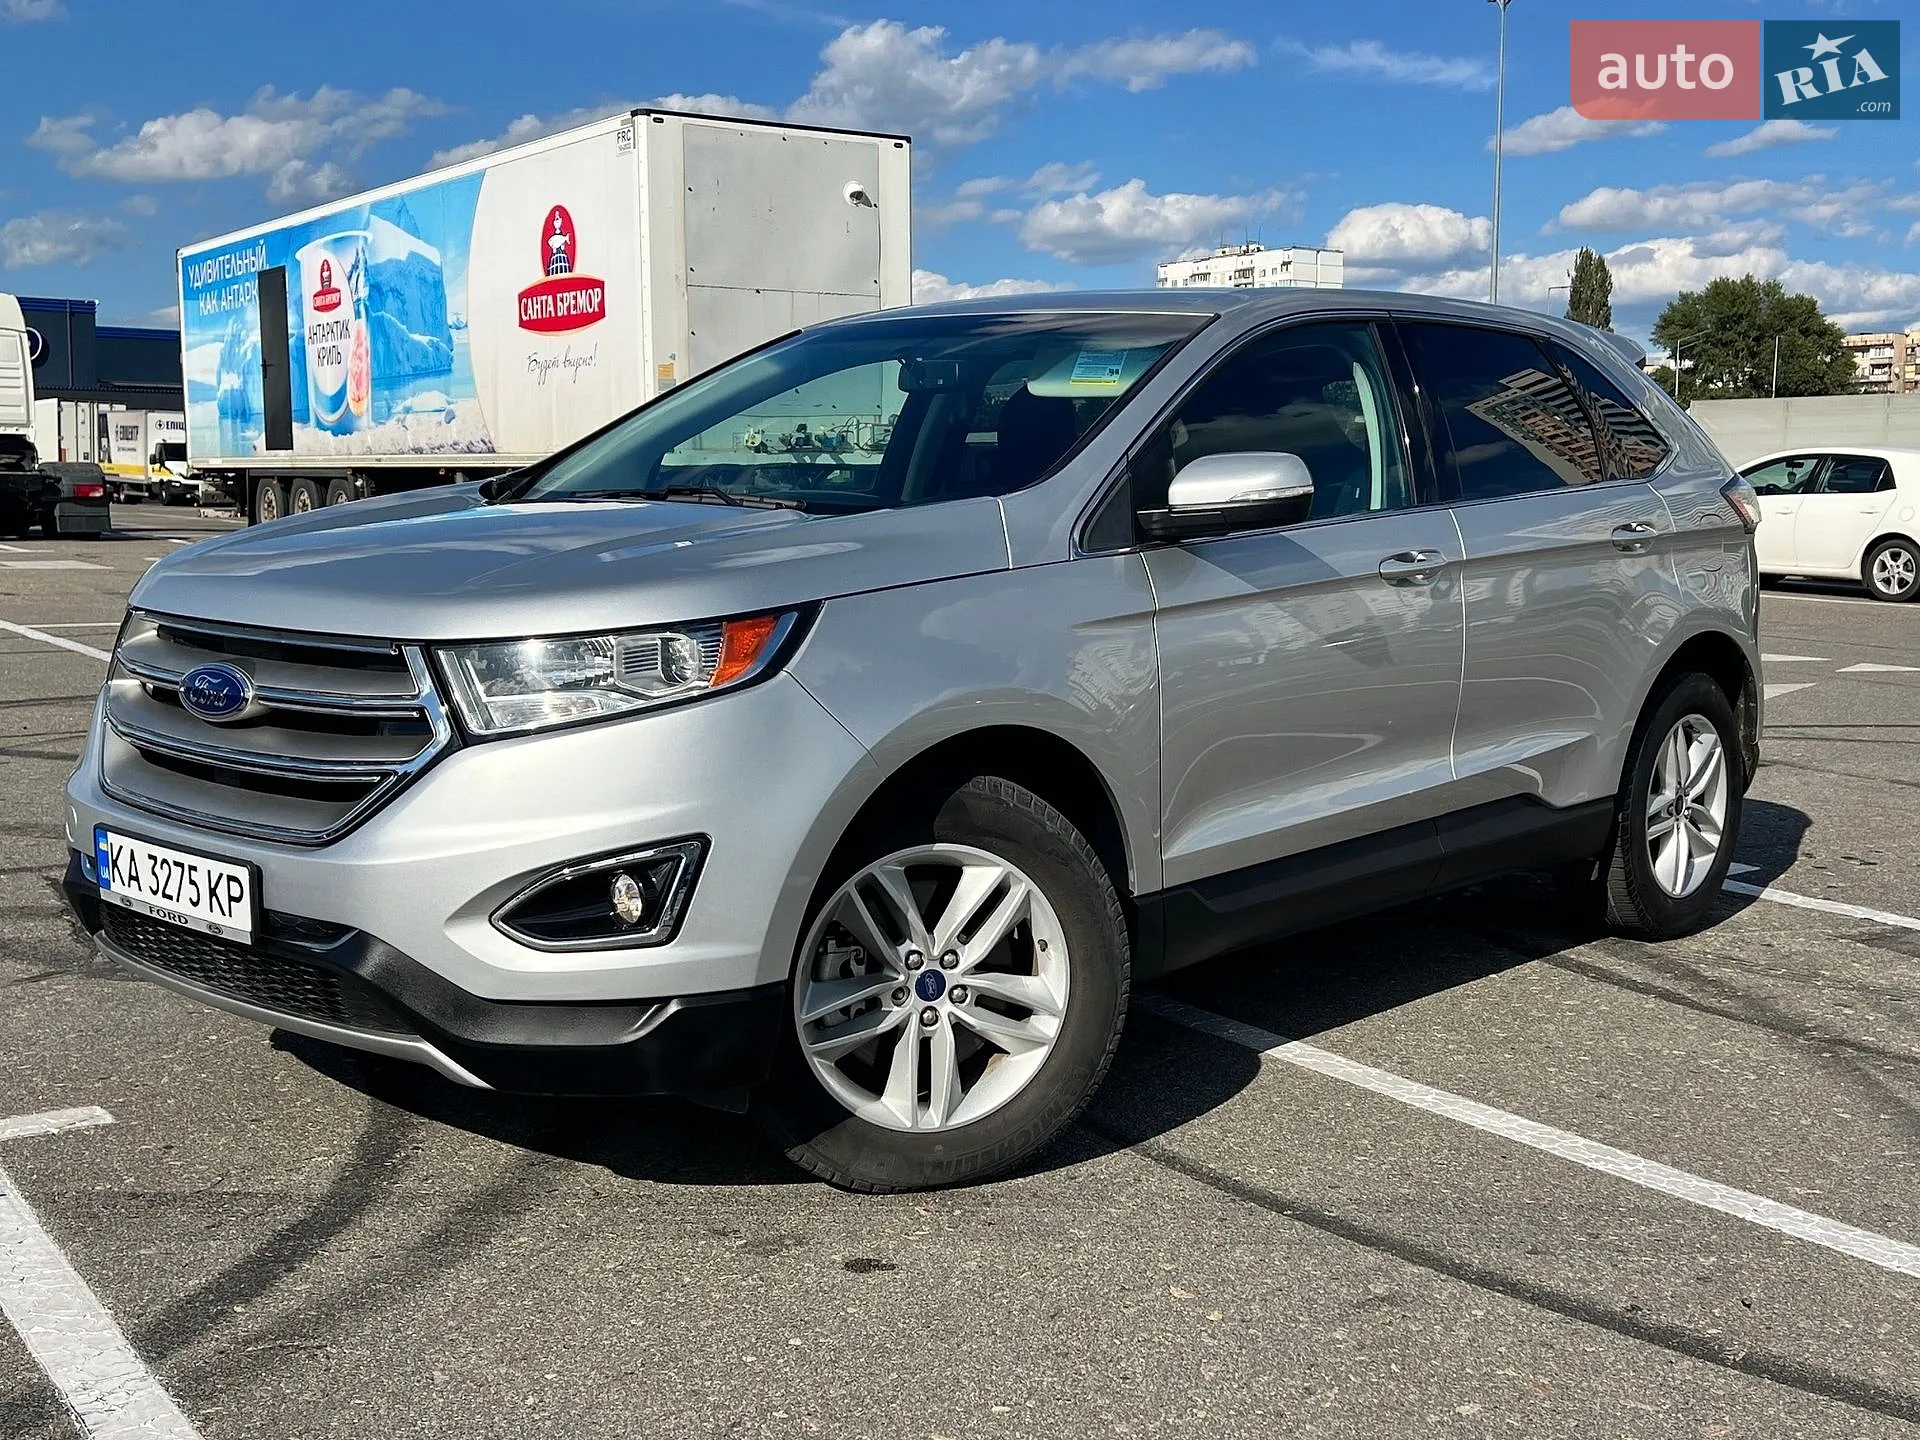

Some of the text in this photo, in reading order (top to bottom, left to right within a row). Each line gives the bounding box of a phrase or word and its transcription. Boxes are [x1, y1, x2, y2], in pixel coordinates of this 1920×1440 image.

[199, 289, 219, 317] КАК
[521, 287, 602, 321] САНТА БРЕМОР
[308, 319, 351, 345] АНТАРКТИК
[317, 344, 342, 367] КРИЛЬ
[190, 674, 229, 707] Ford
[109, 842, 244, 918] KA 3275 KP
[148, 905, 189, 926] FORD
